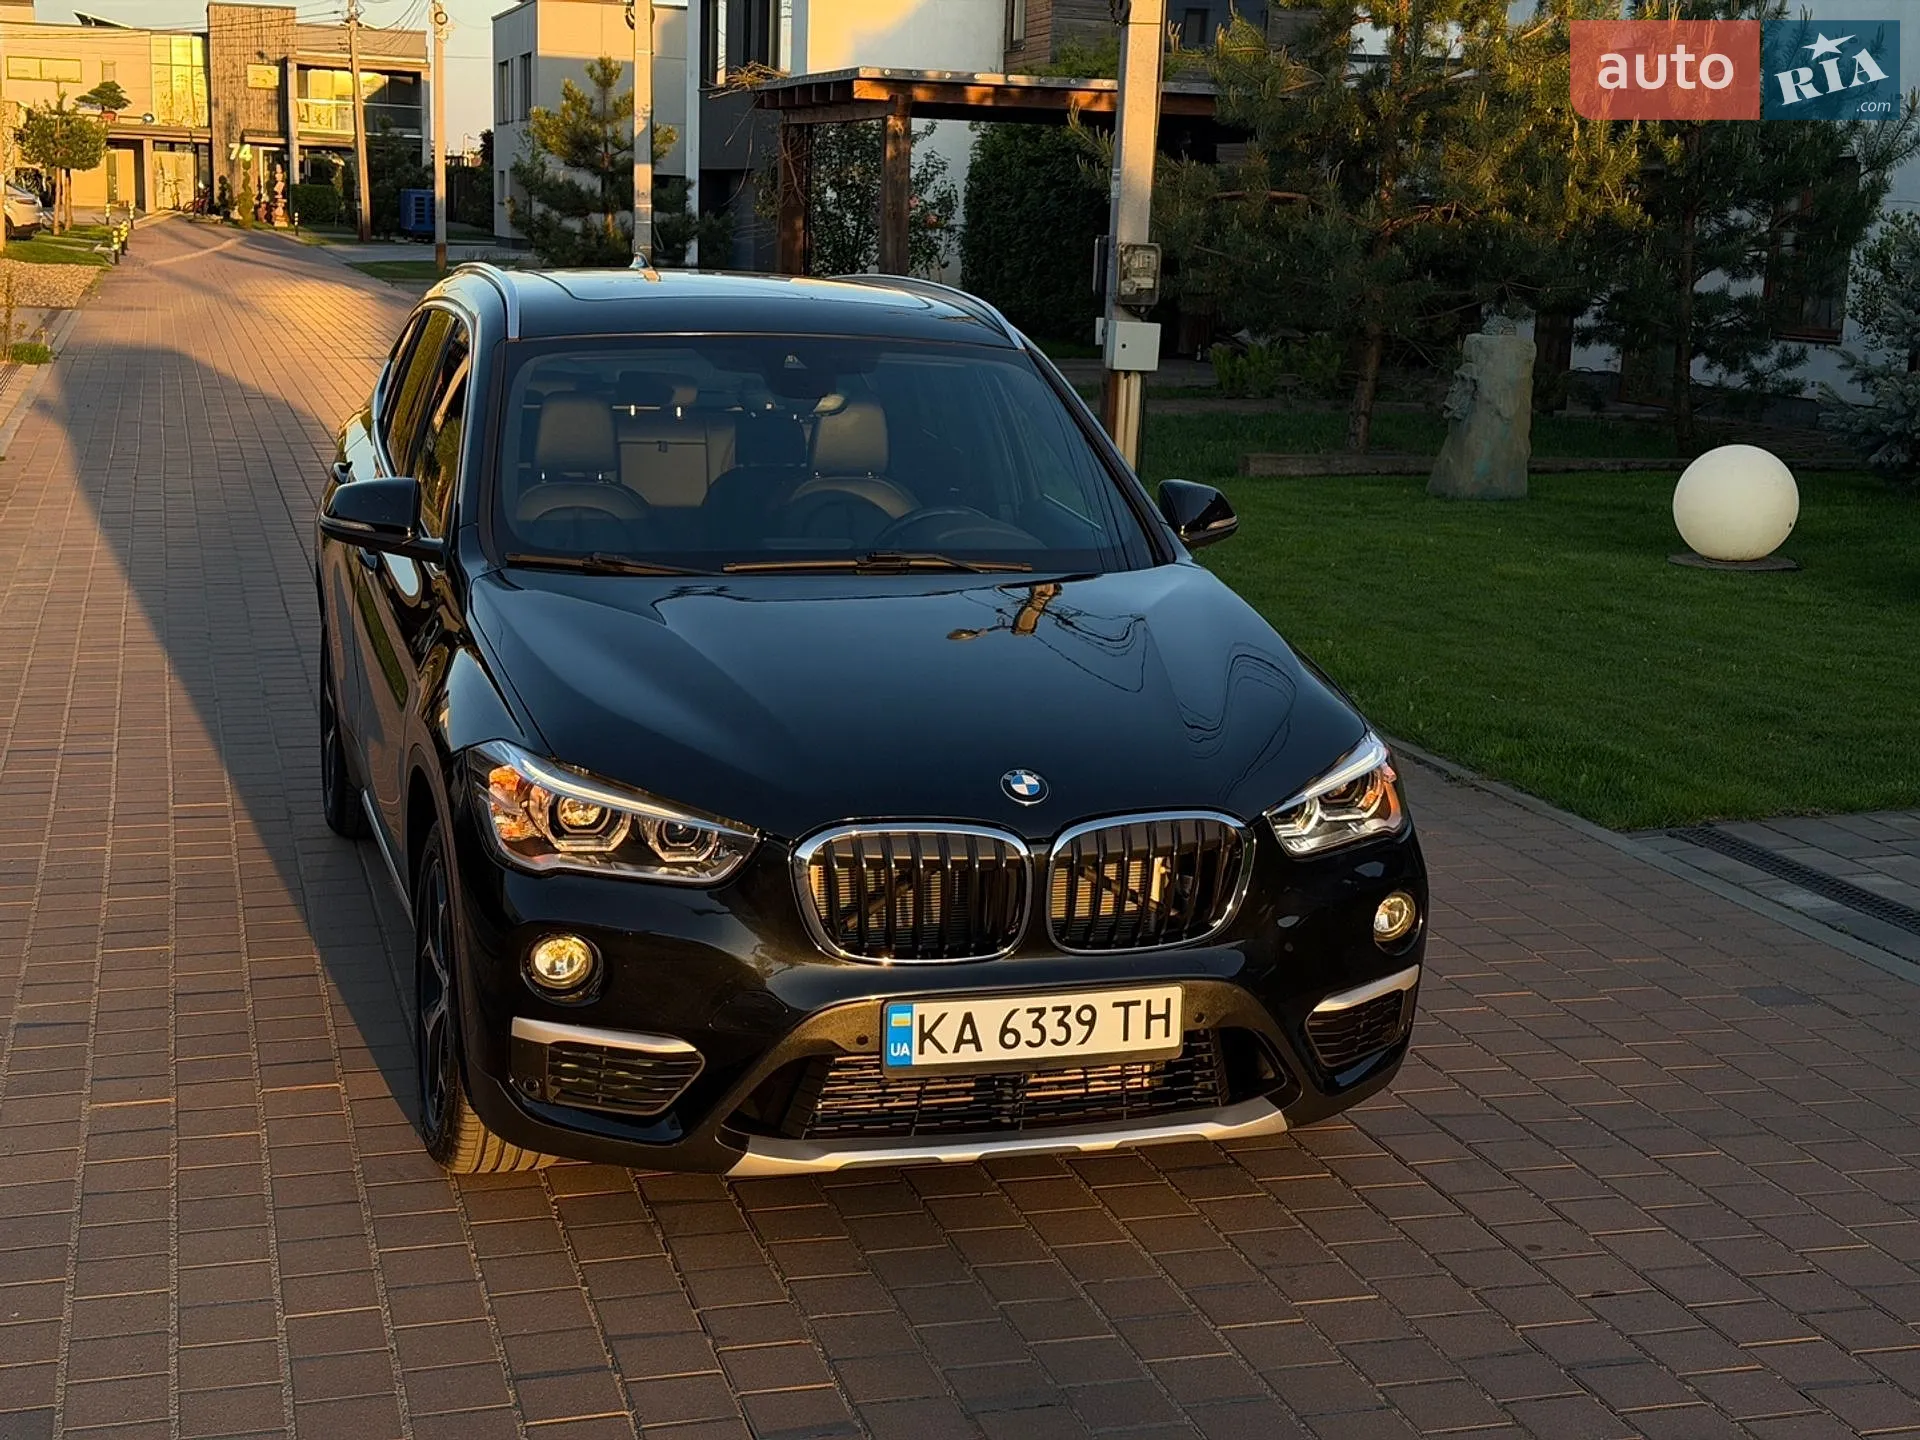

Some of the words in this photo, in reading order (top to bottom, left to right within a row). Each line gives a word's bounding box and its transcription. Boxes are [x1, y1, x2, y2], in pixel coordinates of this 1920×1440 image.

[228, 143, 253, 161] 74
[917, 1011, 983, 1055] KA
[998, 1004, 1097, 1050] 6339
[1112, 997, 1172, 1042] TH
[890, 1042, 910, 1057] UA
